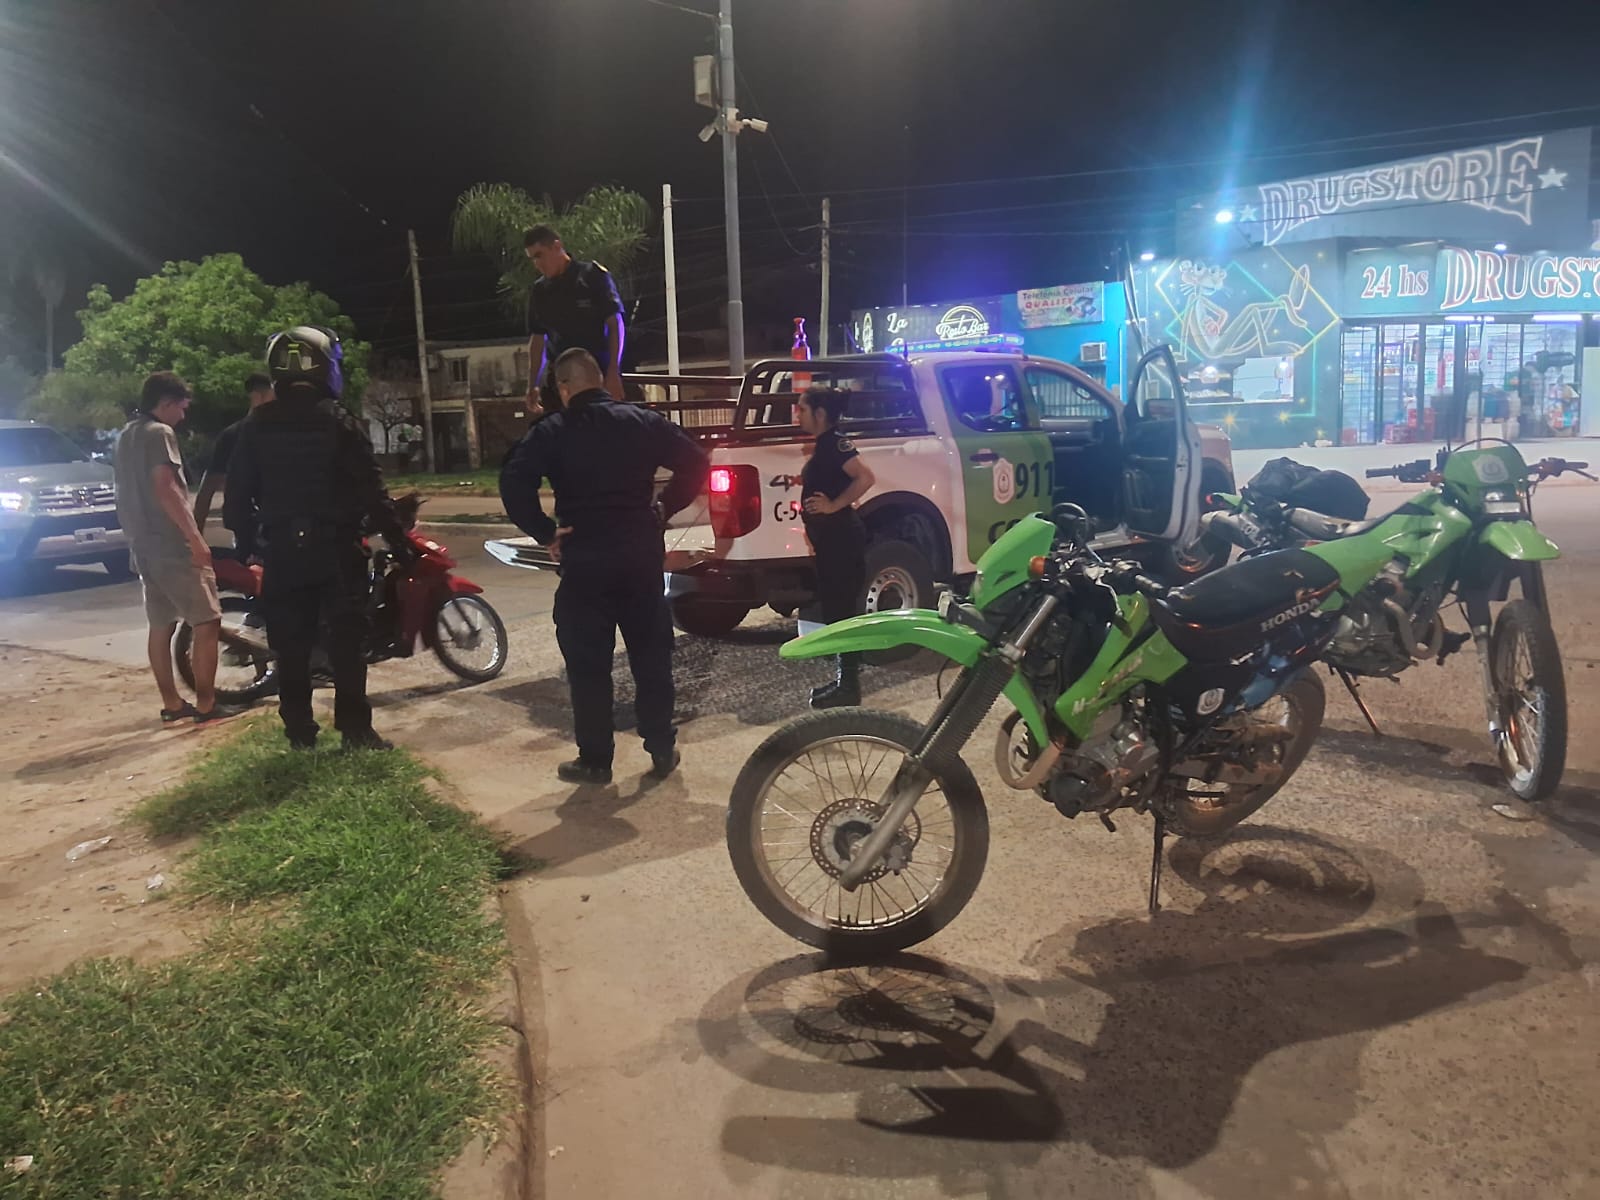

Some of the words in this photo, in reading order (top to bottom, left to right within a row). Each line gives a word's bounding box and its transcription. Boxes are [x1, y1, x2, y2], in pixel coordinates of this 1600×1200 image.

[1259, 137, 1543, 246] DRUGSTORE
[1360, 266, 1392, 298] 24
[1397, 264, 1429, 297] hs
[887, 313, 908, 334] La
[1015, 461, 1054, 500] 911
[1261, 598, 1320, 632] HONDA
